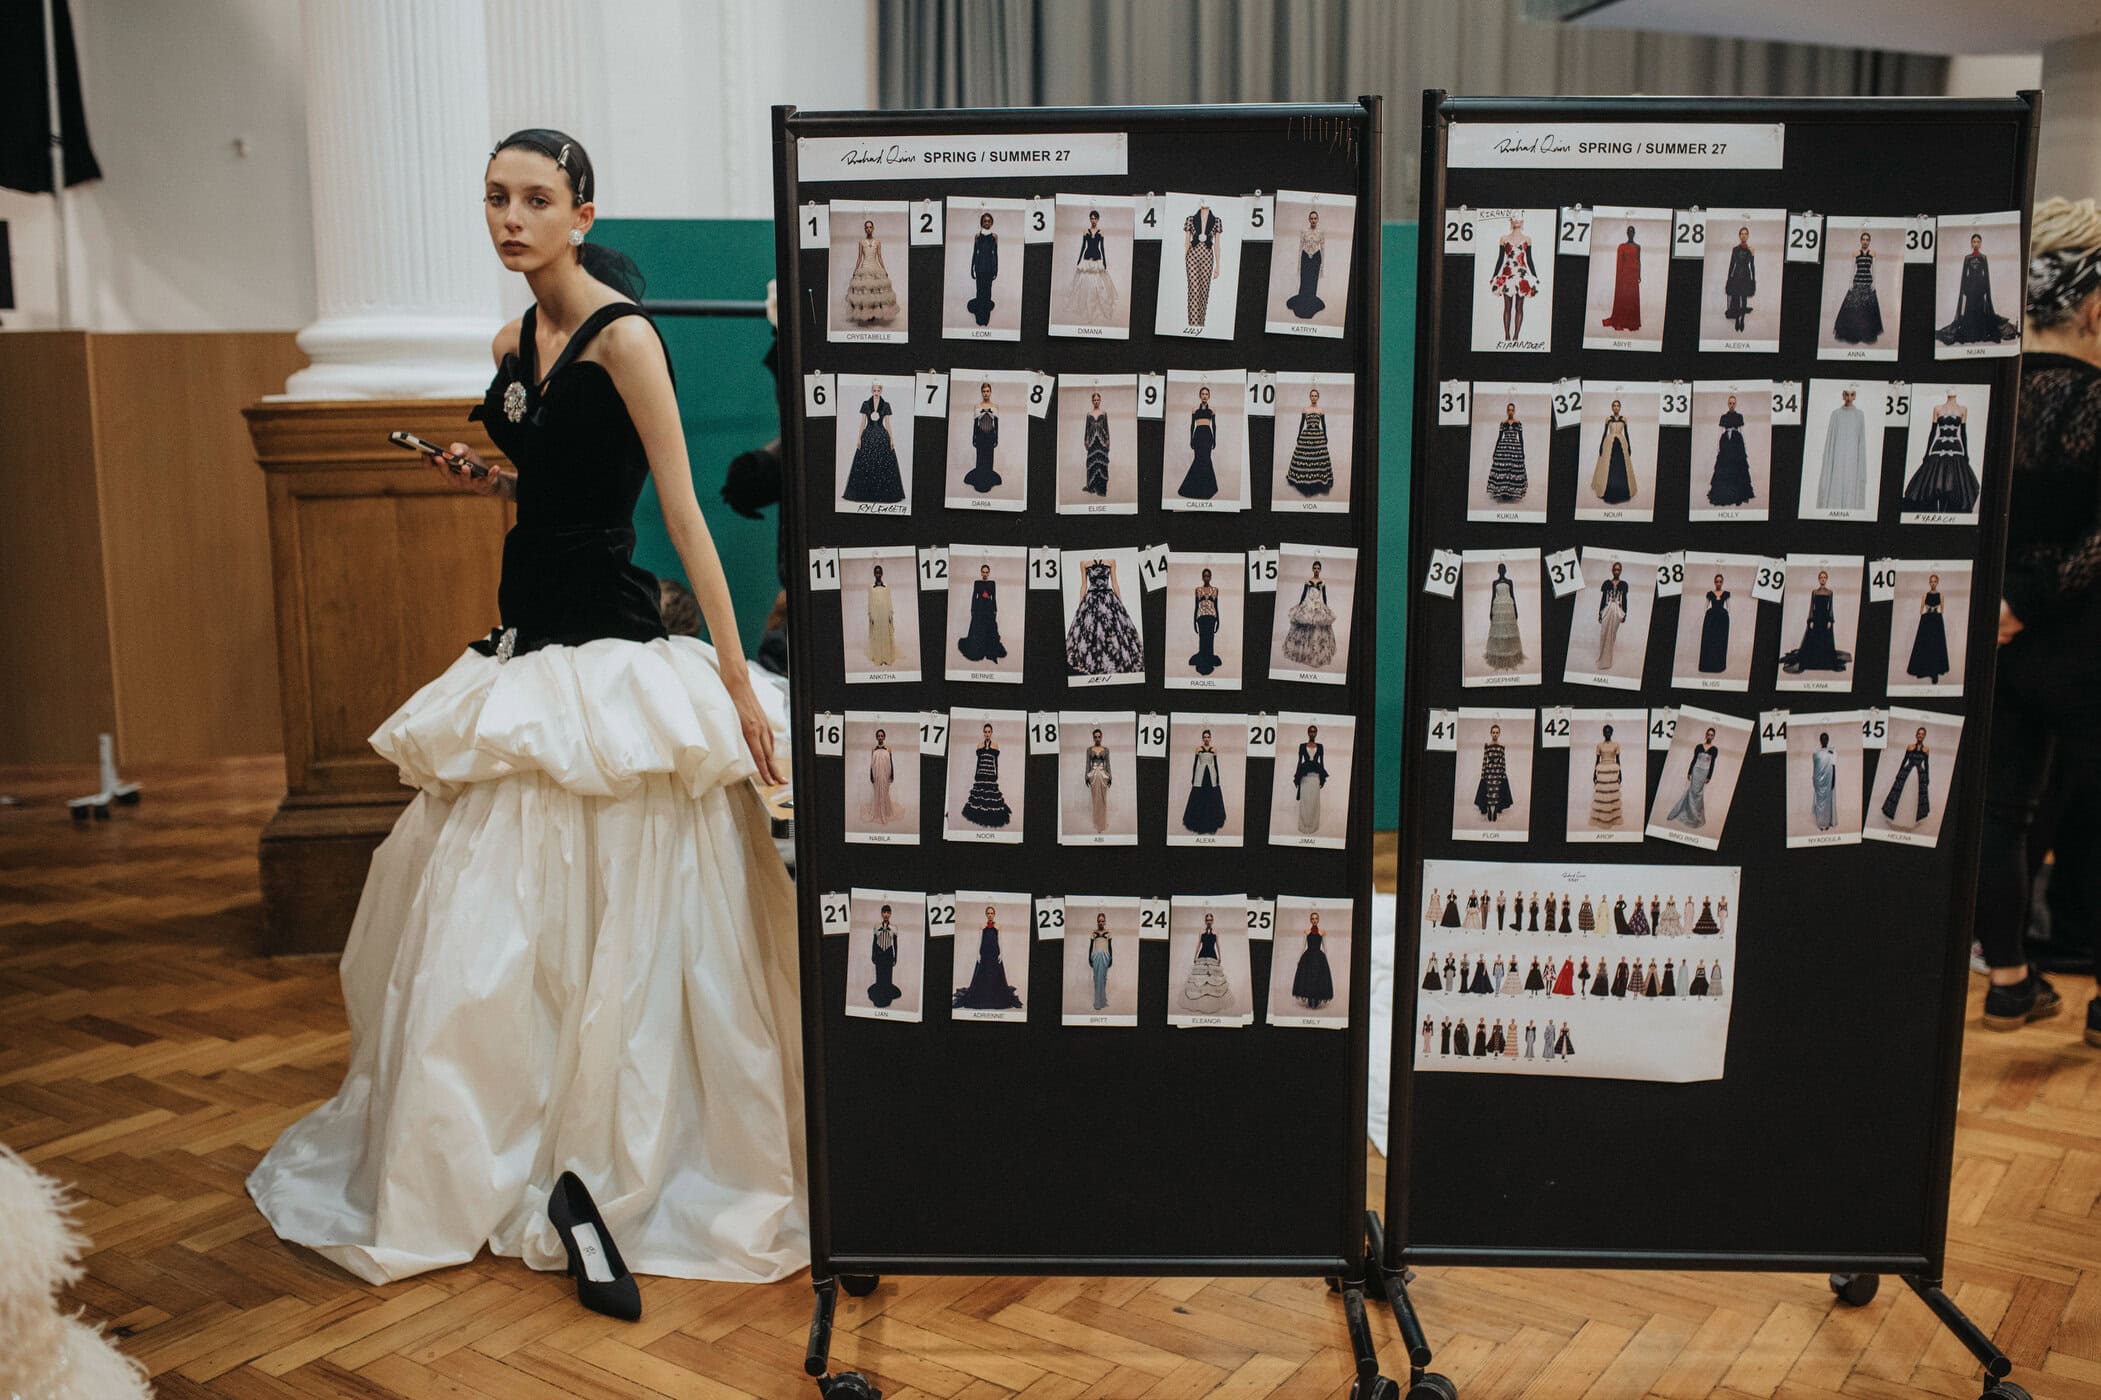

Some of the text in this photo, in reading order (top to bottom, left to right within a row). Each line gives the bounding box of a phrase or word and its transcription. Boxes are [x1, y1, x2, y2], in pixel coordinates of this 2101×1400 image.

[923, 151, 977, 164] SPRING
[980, 151, 986, 163] /
[990, 150, 1051, 163] SUMMER
[1055, 150, 1071, 163] 27
[1578, 141, 1633, 155] SPRING
[1636, 141, 1641, 155] /
[1645, 141, 1708, 156] SUMMER
[1711, 142, 1727, 156] 27
[807, 216, 818, 237] 1
[919, 213, 934, 233] 2
[1032, 210, 1046, 231] 3
[1142, 207, 1157, 228] 4
[1251, 207, 1265, 228] 5
[1446, 222, 1473, 242] 26
[1561, 222, 1590, 242] 27
[1677, 224, 1704, 244] 28
[1790, 229, 1818, 249] 29
[1906, 230, 1933, 250] 30
[846, 333, 891, 341] CRYSTABELLE
[971, 330, 992, 338] LEOMI
[1291, 325, 1317, 334] KATRYN
[813, 385, 826, 405] 6
[925, 384, 938, 404] 7
[1029, 384, 1045, 404] 8
[1144, 385, 1157, 405] 9
[1249, 384, 1275, 404] 10
[1441, 392, 1466, 413] 31
[1555, 391, 1582, 415] 32
[1662, 394, 1687, 413] 33
[1772, 394, 1797, 413] 34
[1718, 511, 1739, 519] HOLLY
[812, 559, 836, 579] 11
[921, 559, 948, 579] 12
[1031, 559, 1058, 579] 13
[1144, 554, 1168, 579] 14
[1251, 560, 1278, 580] 15
[1430, 562, 1457, 585] 36
[1550, 560, 1577, 585] 37
[1658, 564, 1683, 585] 38
[1757, 568, 1785, 590] 39
[1872, 570, 1895, 588] 40
[1485, 676, 1520, 684] JOSEPHINE
[815, 724, 840, 744] 16
[920, 724, 945, 743] 17
[1031, 723, 1057, 743] 18
[1139, 726, 1165, 745] 19
[1250, 726, 1276, 745] 20
[1431, 721, 1455, 740] 41
[1544, 718, 1570, 737] 42
[1651, 719, 1676, 739] 43
[1762, 722, 1787, 741] 44
[1862, 720, 1885, 739] 45
[824, 904, 848, 923] 21
[930, 905, 955, 925] 22
[1038, 909, 1064, 929] 23
[1141, 909, 1167, 929] 24
[1248, 911, 1272, 929] 25
[1192, 1017, 1221, 1025] ELEANOR
